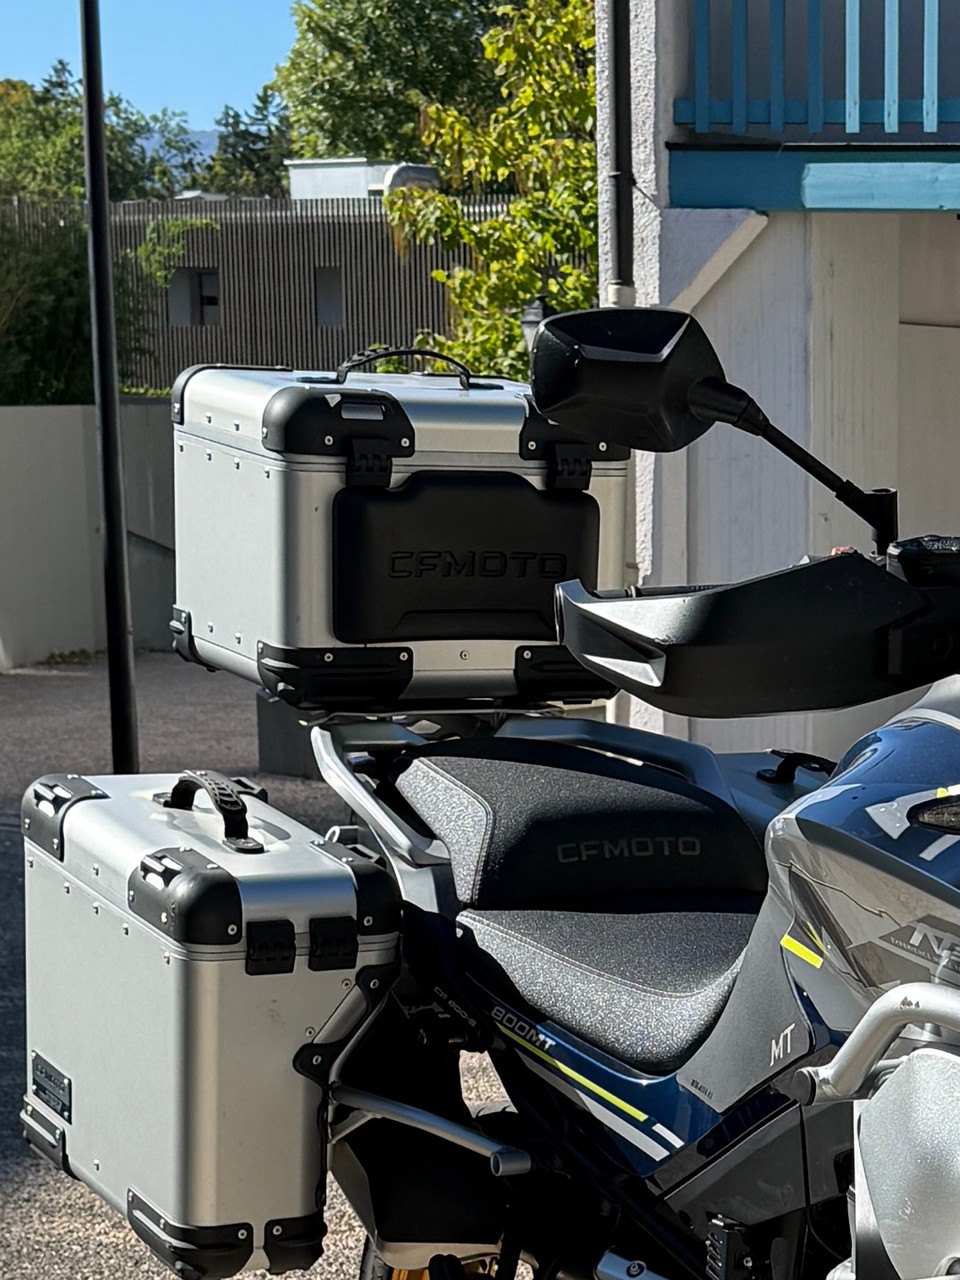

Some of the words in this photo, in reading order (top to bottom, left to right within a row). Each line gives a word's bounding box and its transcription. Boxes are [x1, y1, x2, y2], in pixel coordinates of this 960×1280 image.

[388, 551, 568, 578] CFMOTO
[557, 836, 701, 863] CFMOTO
[491, 1005, 556, 1050] 800MT
[769, 1022, 796, 1067] MT
